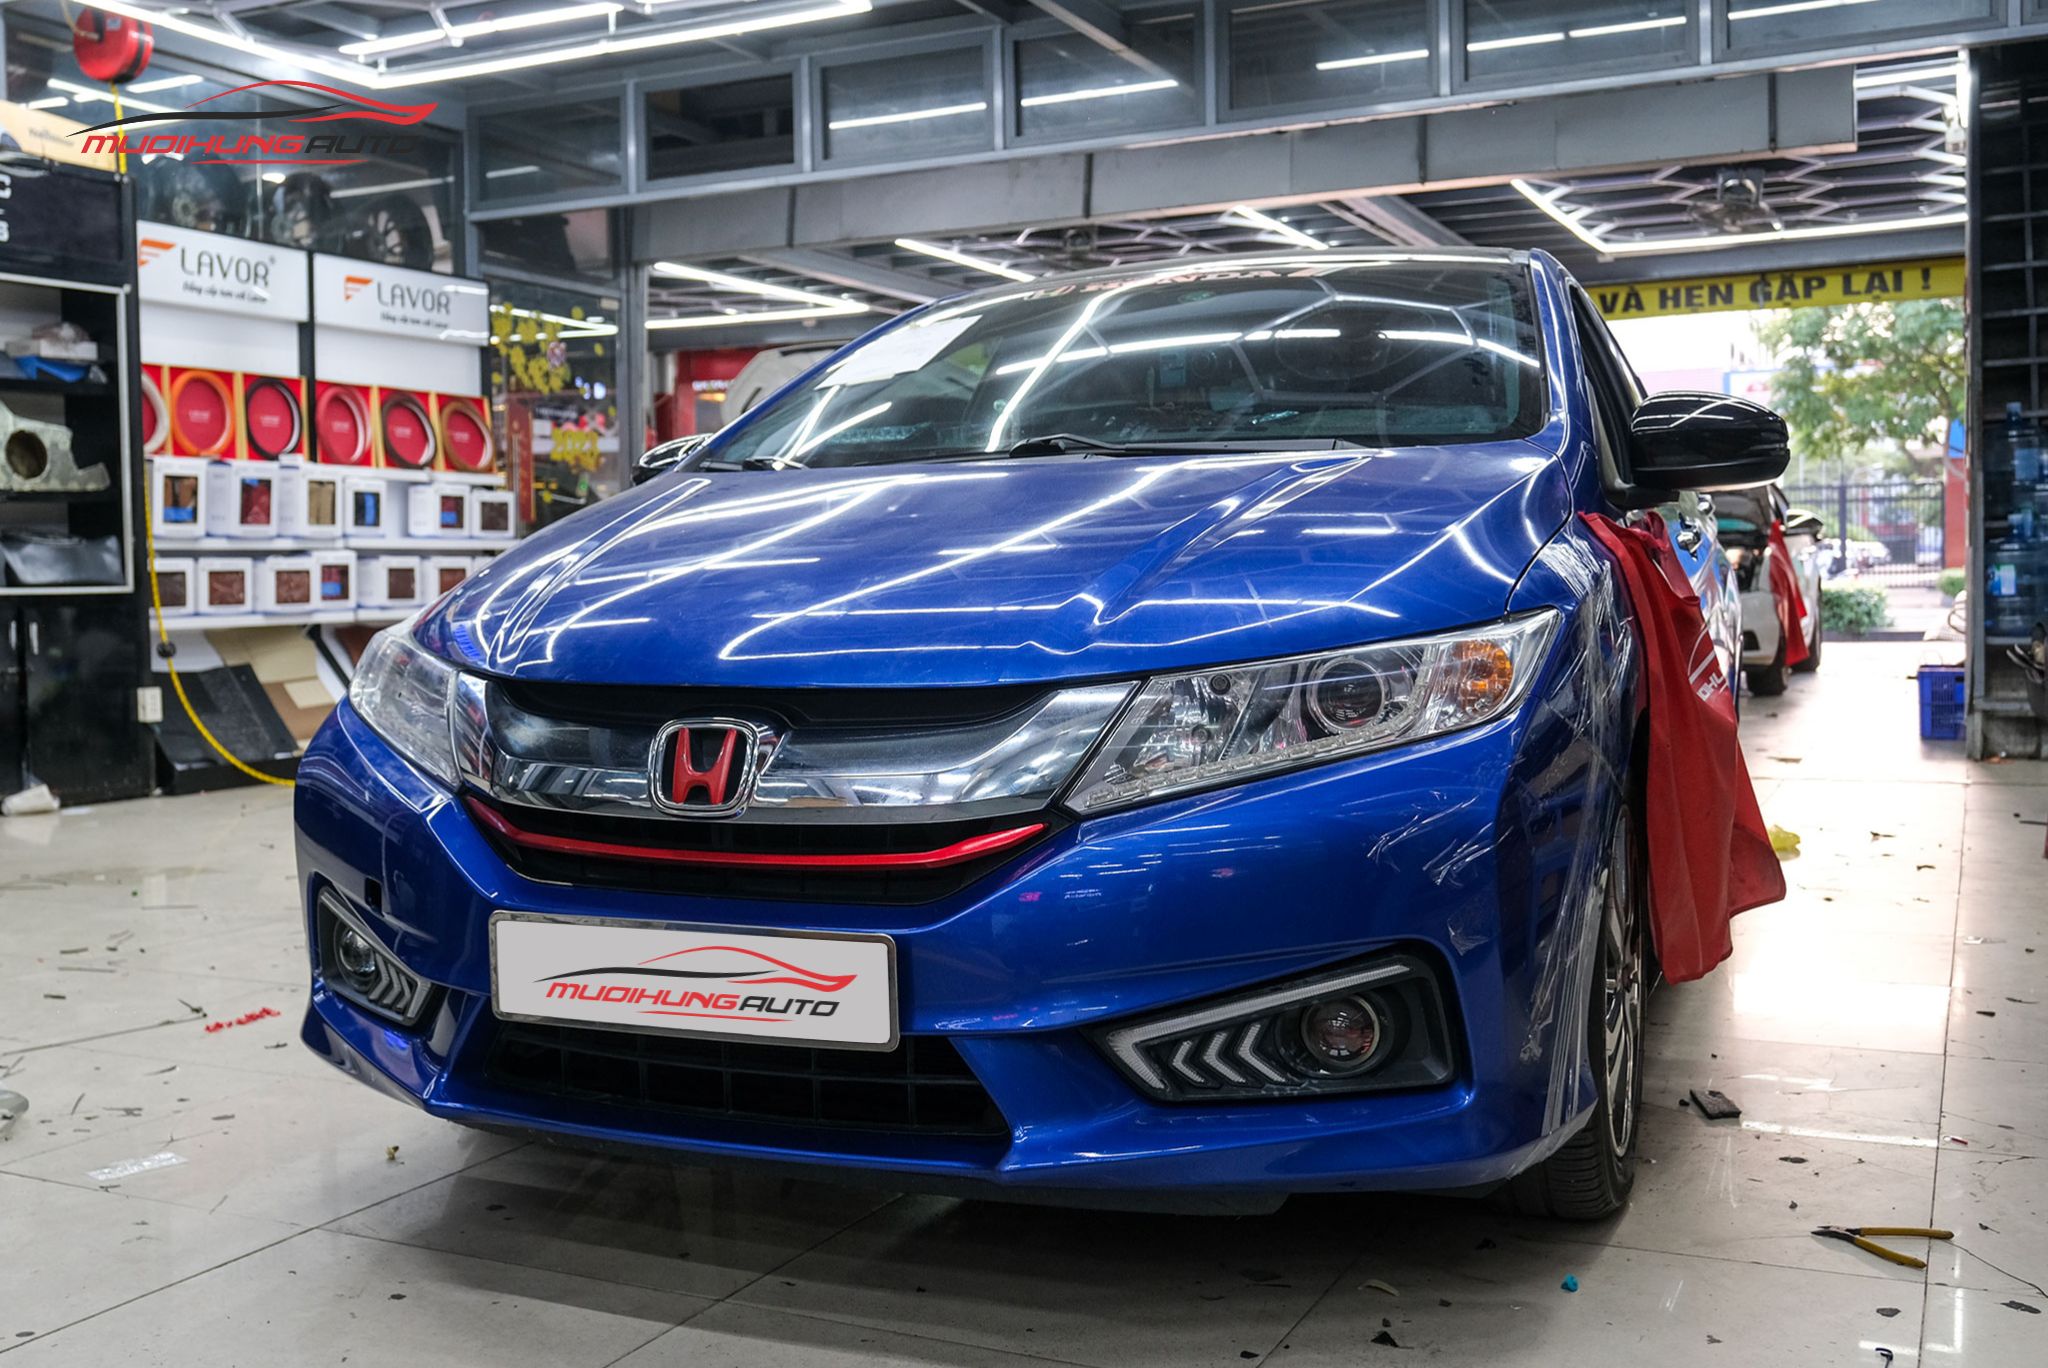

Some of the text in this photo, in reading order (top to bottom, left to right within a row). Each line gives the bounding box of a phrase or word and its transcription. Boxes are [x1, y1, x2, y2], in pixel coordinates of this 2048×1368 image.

[181, 246, 269, 287] LAVOR
[377, 281, 450, 315] LAVOR
[1599, 285, 1646, 314] VÀ
[1842, 267, 1903, 300] LẠI
